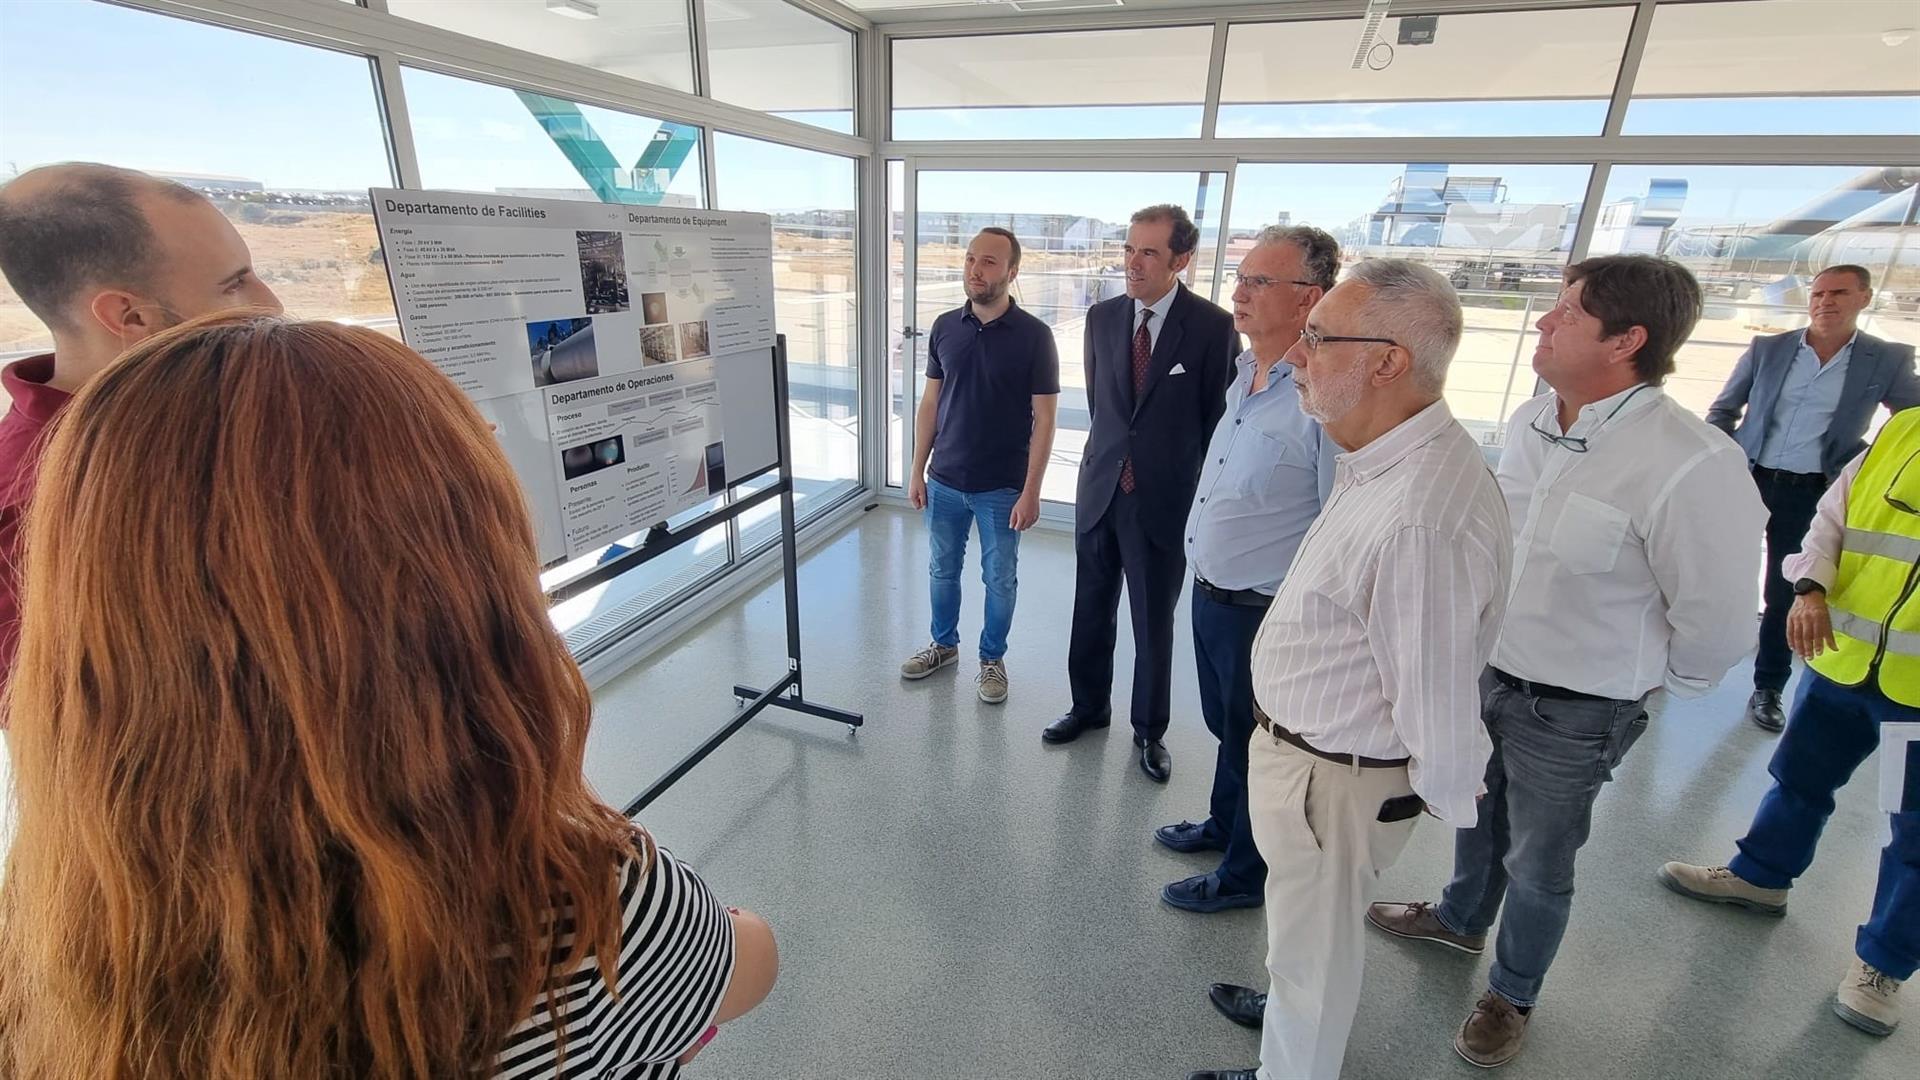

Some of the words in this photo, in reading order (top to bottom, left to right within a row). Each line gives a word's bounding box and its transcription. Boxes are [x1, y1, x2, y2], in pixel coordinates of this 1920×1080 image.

[385, 199, 479, 216] Departamento
[481, 204, 496, 217] de
[498, 205, 547, 219] Facilities
[628, 212, 681, 225] Departamento
[682, 215, 692, 225] de
[692, 216, 728, 227] Equipment
[400, 271, 416, 279] Agua
[551, 385, 614, 405] Departamento
[615, 381, 626, 392] de
[627, 372, 675, 392] Operaciones
[556, 412, 583, 424] Proceso
[626, 462, 651, 475] Producto
[569, 480, 599, 494] Personas
